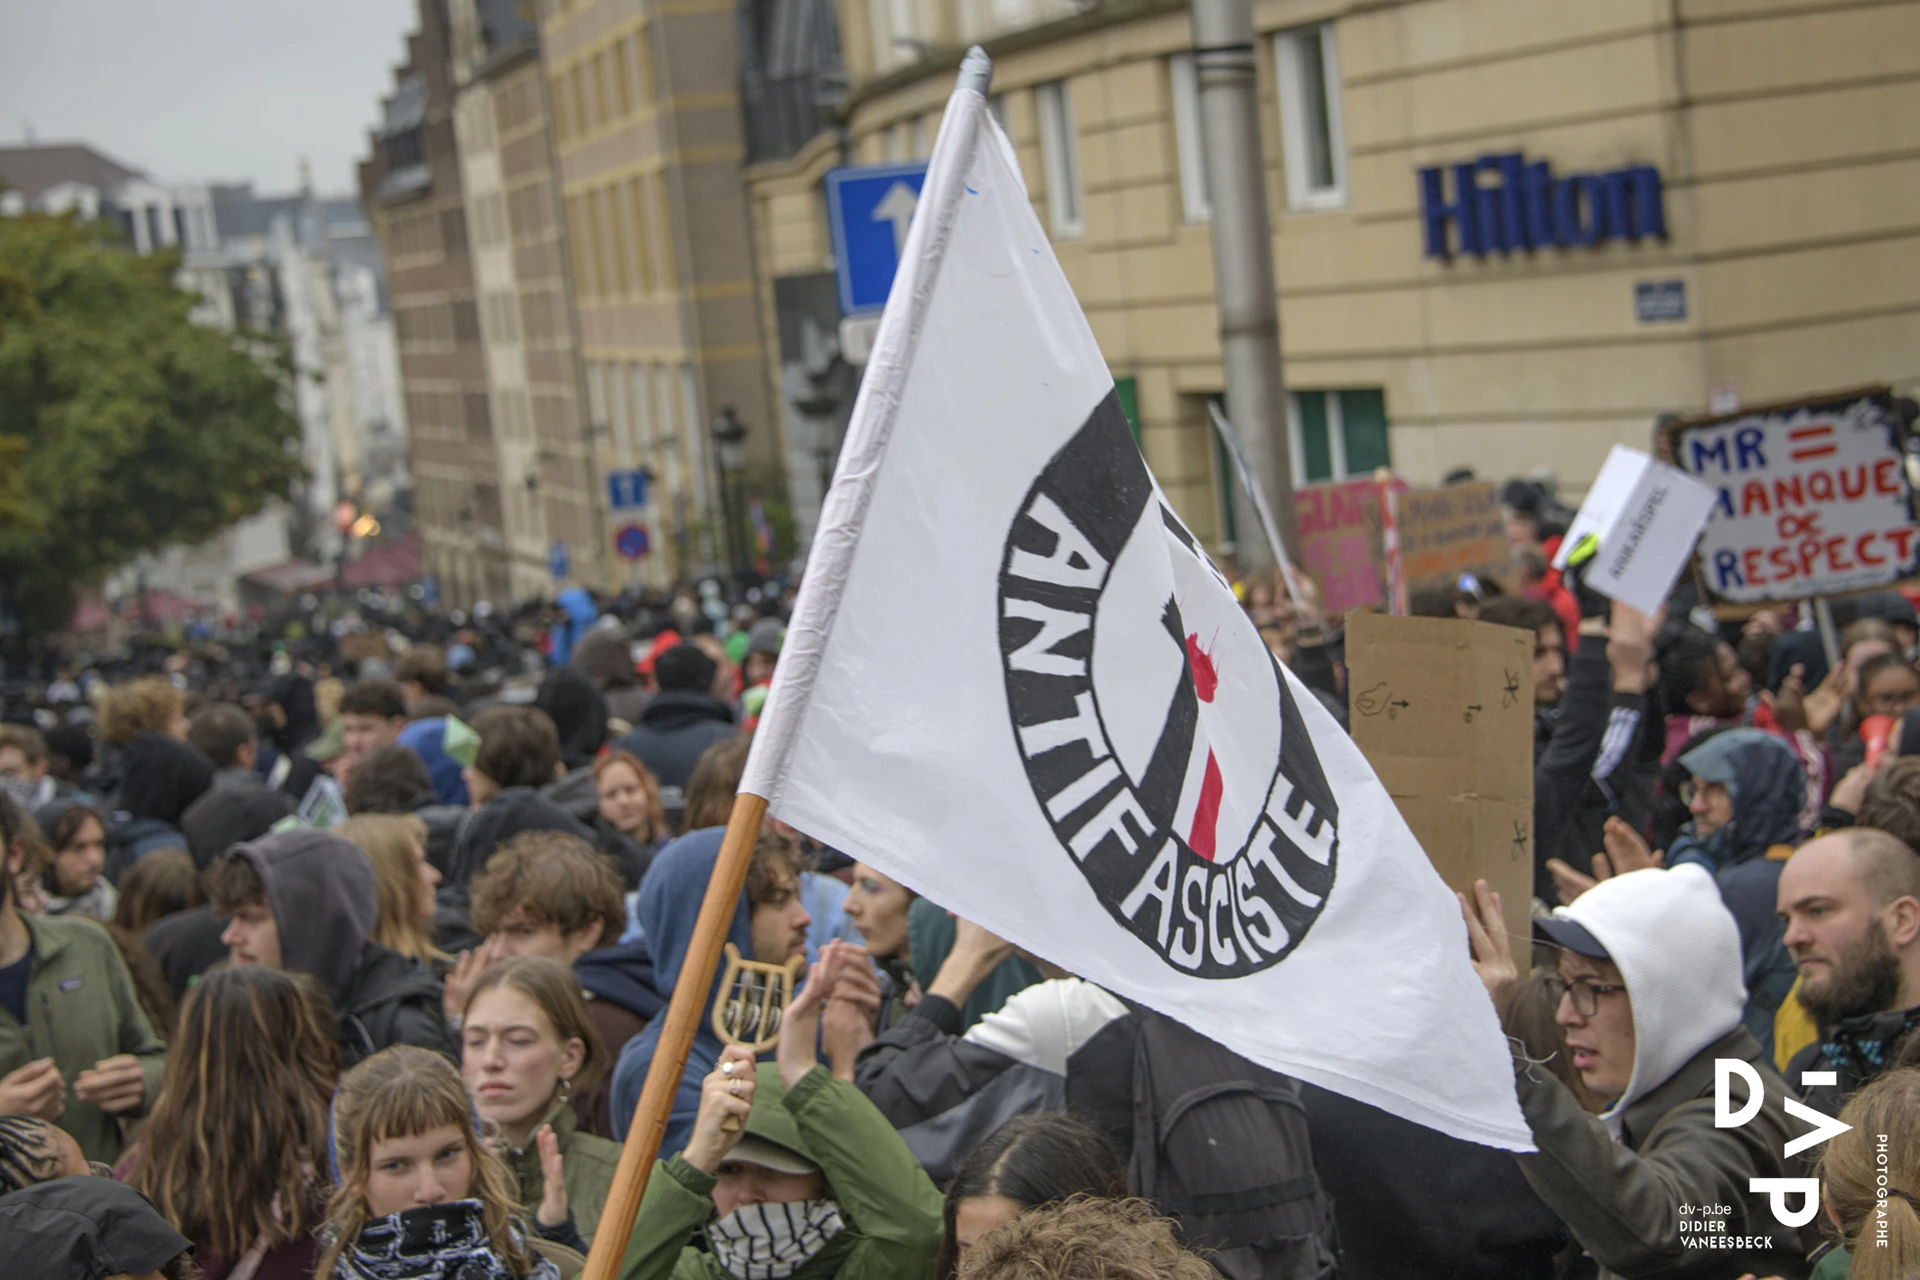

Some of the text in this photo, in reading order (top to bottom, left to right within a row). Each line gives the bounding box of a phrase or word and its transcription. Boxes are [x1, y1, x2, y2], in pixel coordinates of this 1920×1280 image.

[1418, 154, 1665, 257] Hilton
[1691, 427, 1766, 472] MR
[1777, 511, 1822, 540] DE
[1714, 529, 1915, 589] RESPECT
